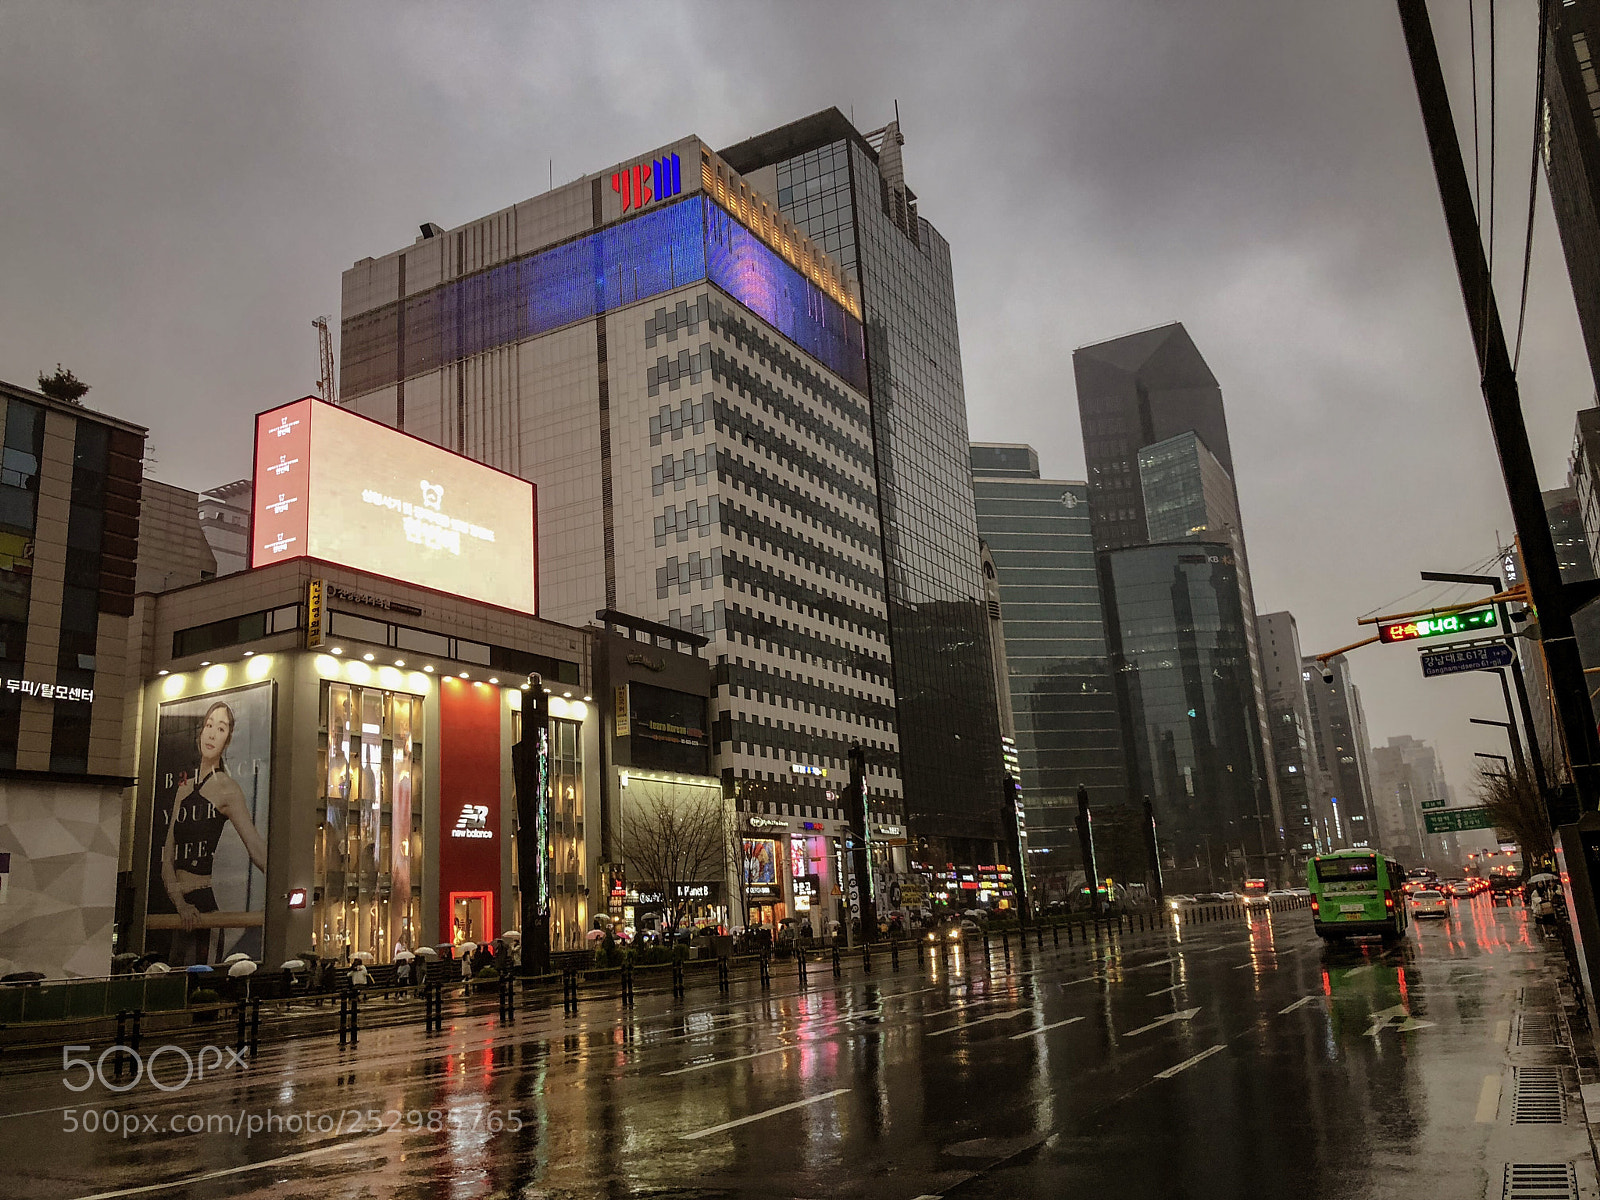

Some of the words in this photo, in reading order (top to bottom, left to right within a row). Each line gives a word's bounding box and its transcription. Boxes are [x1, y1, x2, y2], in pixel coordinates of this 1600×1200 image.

[612, 152, 681, 213] YBM
[1424, 648, 1488, 668] 강남대로61길
[6, 678, 94, 703] 두피/탈모센터
[162, 802, 217, 825] YOUR
[451, 829, 466, 838] new
[466, 828, 493, 839] balance
